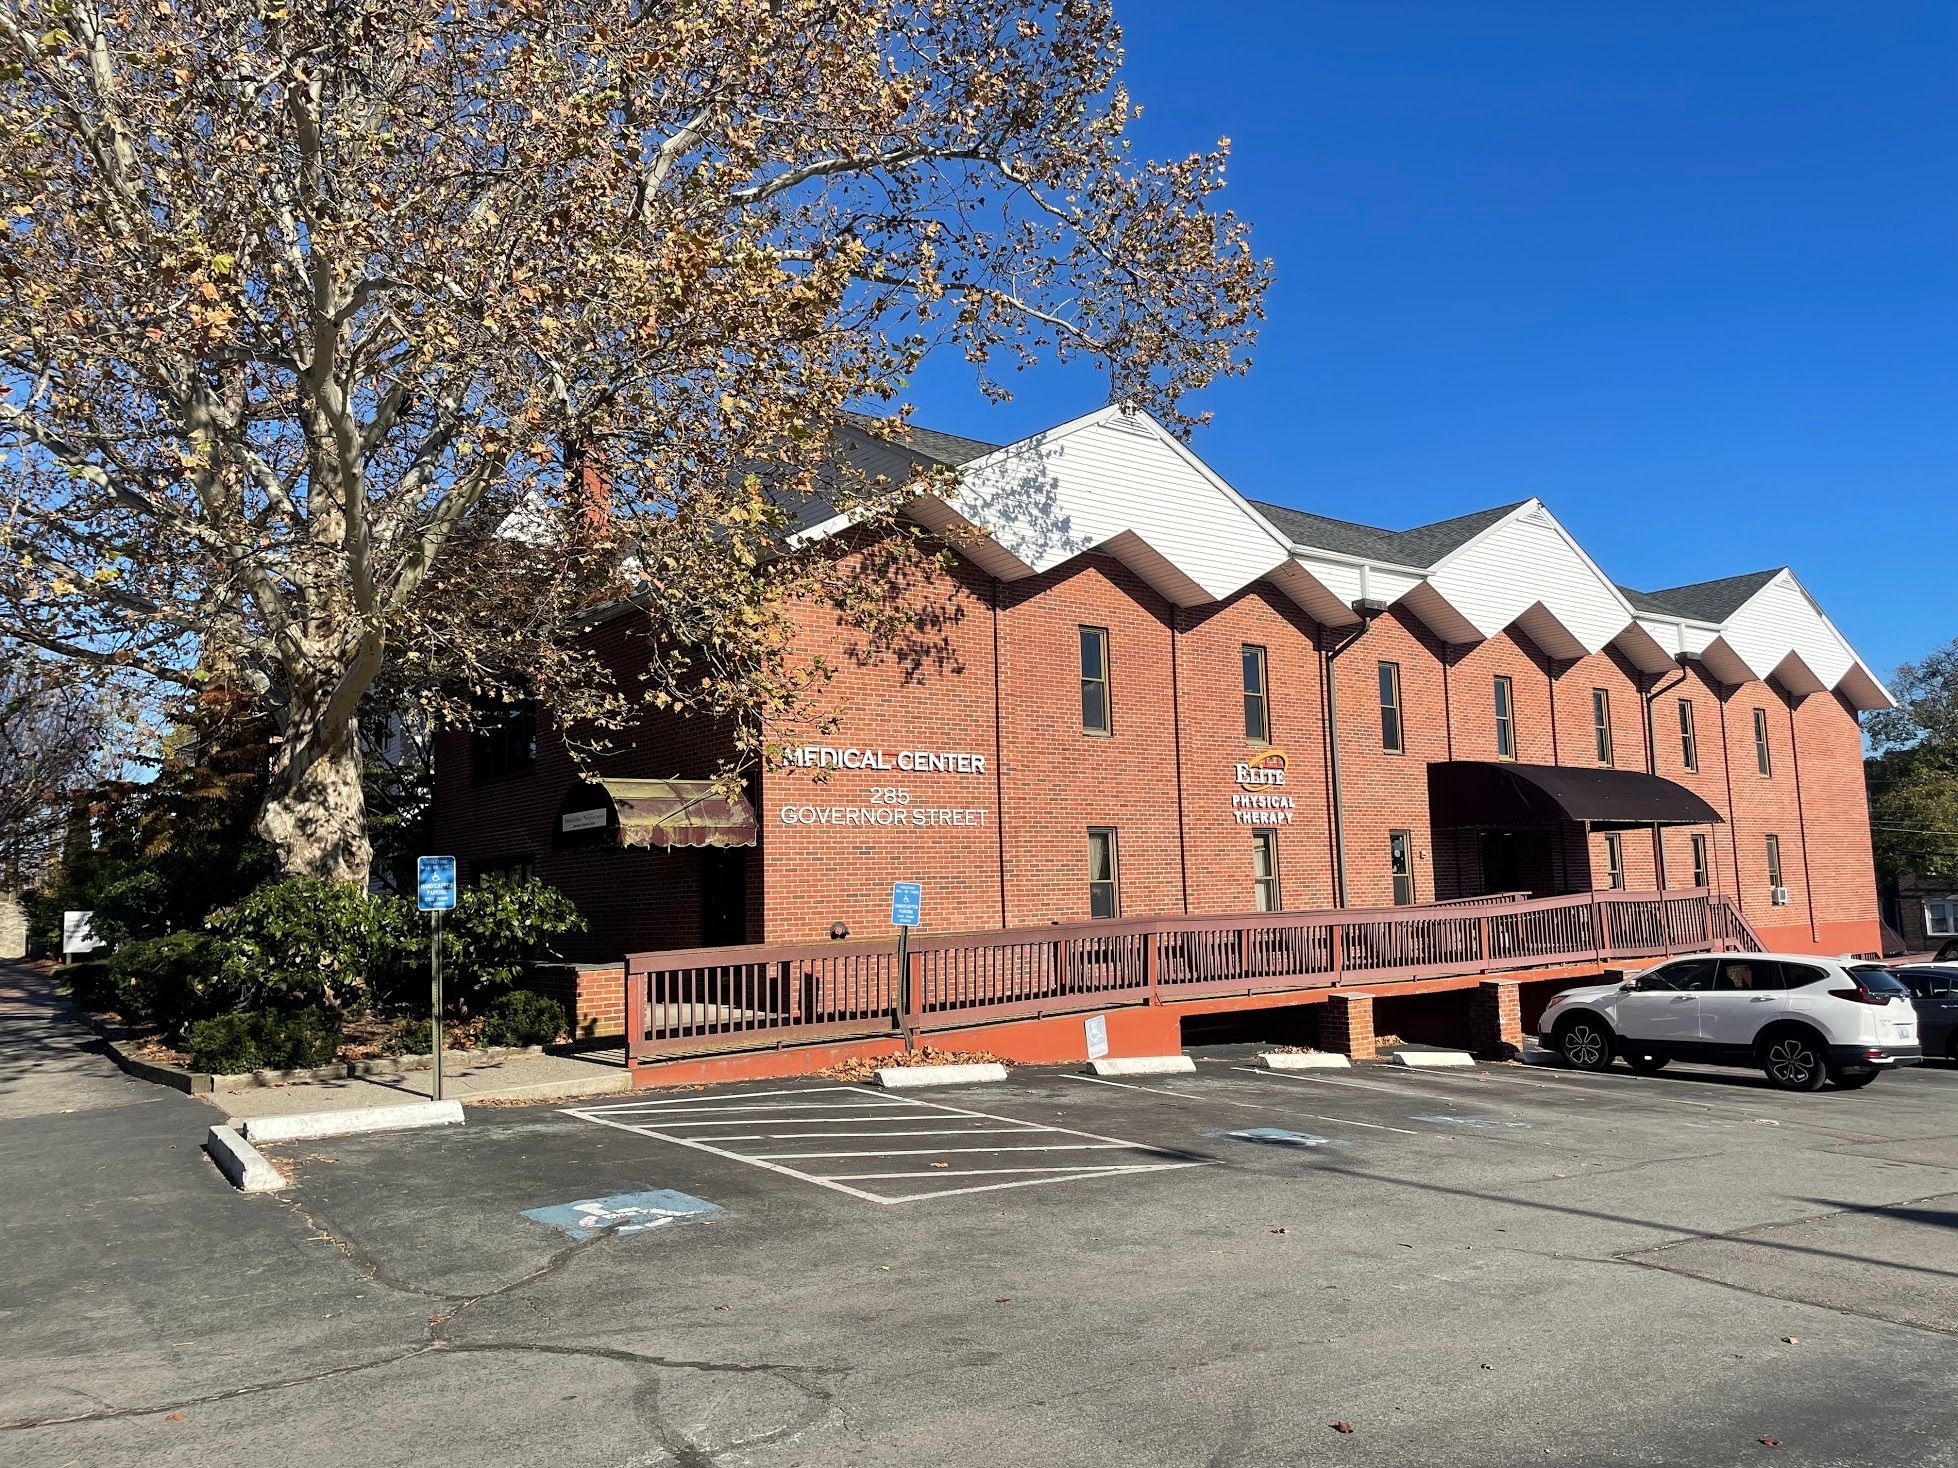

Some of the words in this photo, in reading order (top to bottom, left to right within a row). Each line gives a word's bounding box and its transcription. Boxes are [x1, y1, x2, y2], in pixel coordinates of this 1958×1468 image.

[783, 747, 891, 770] MEDICAL
[897, 751, 986, 773] CENTER
[1234, 763, 1286, 785] ELITE
[869, 787, 910, 805] 285
[1232, 794, 1296, 808] PHYSICAL
[780, 806, 907, 826] GOVERNOR
[912, 808, 989, 827] STREET
[1233, 810, 1294, 824] THERAPY
